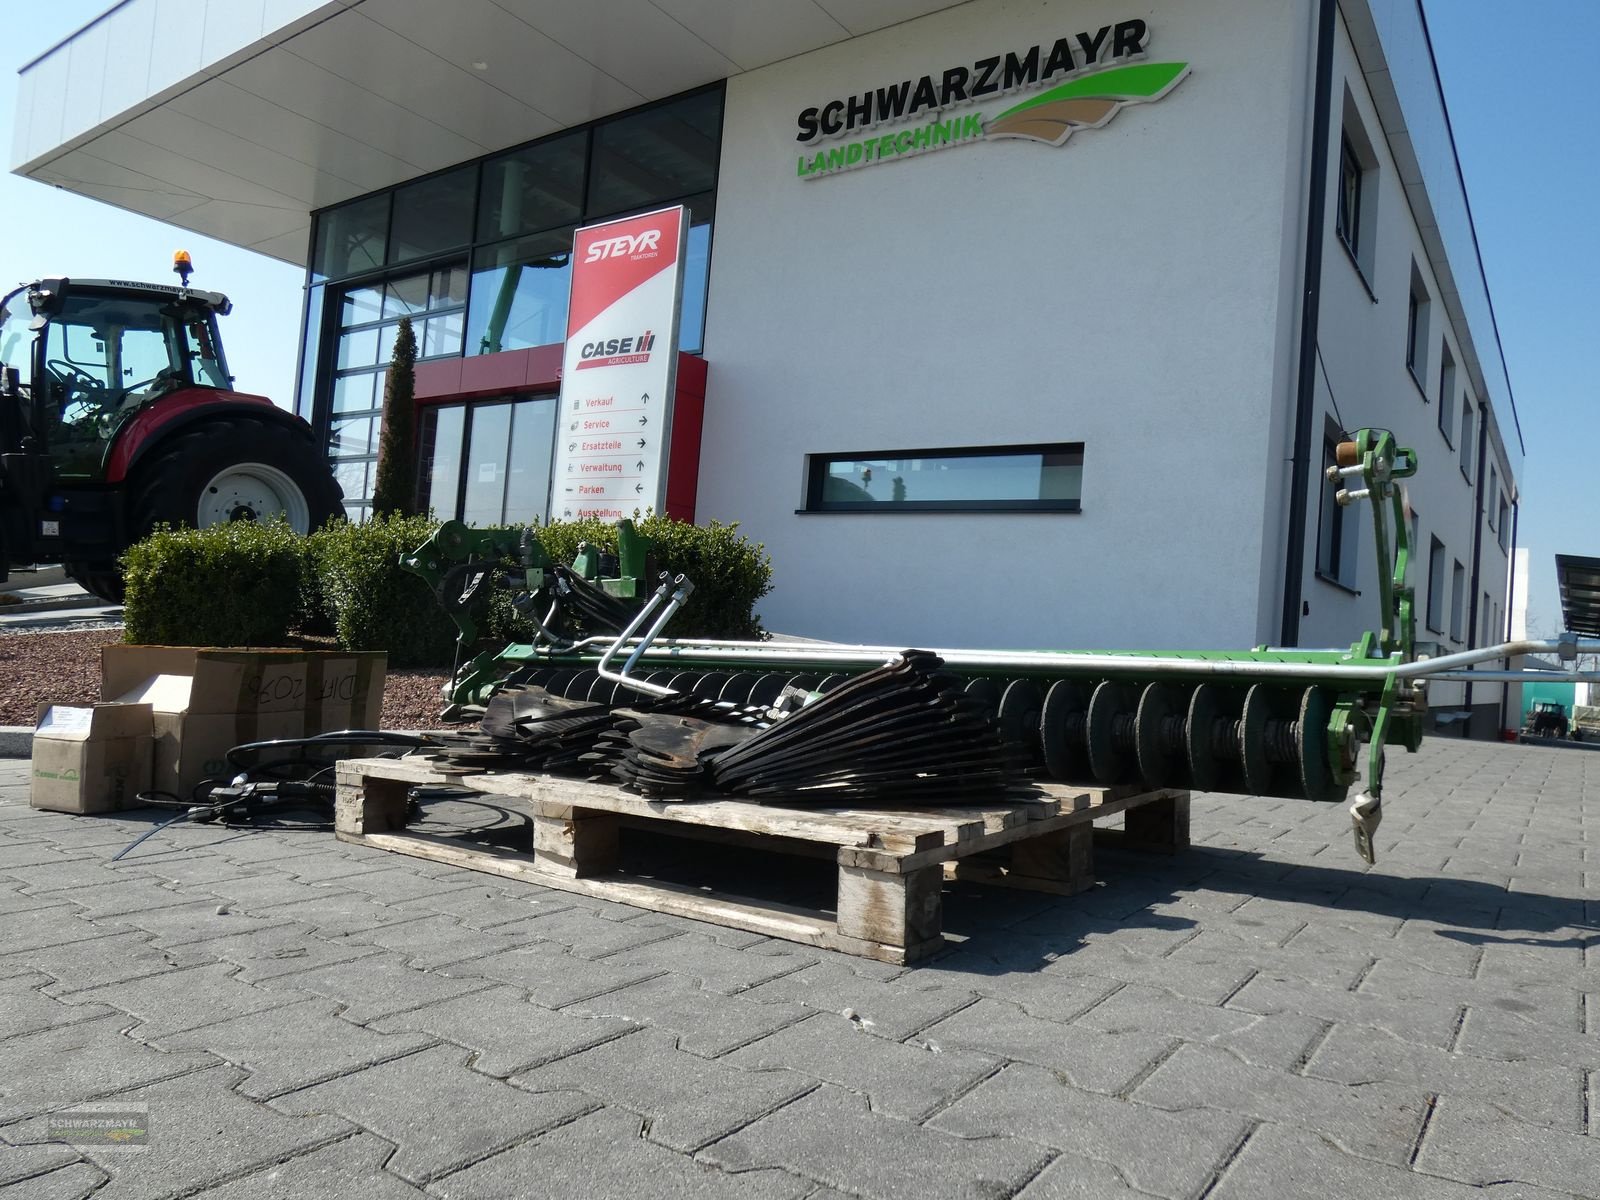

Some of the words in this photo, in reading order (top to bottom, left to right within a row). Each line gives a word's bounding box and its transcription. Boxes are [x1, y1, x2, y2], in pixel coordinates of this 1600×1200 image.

[797, 19, 1147, 142] SCHWARZMAYR
[797, 112, 983, 177] LANDTECHNIK
[584, 229, 661, 264] STEYR
[631, 252, 658, 261] TRAKTOREN
[581, 337, 633, 359] CASE
[608, 354, 648, 365] AGRICULTURE
[586, 396, 613, 407] Verkauf
[584, 420, 610, 429] Service
[582, 440, 622, 451] Ersatzteile
[580, 463, 622, 473] Verwaltung
[579, 485, 604, 494] Parken
[577, 508, 622, 518] Ausstellung
